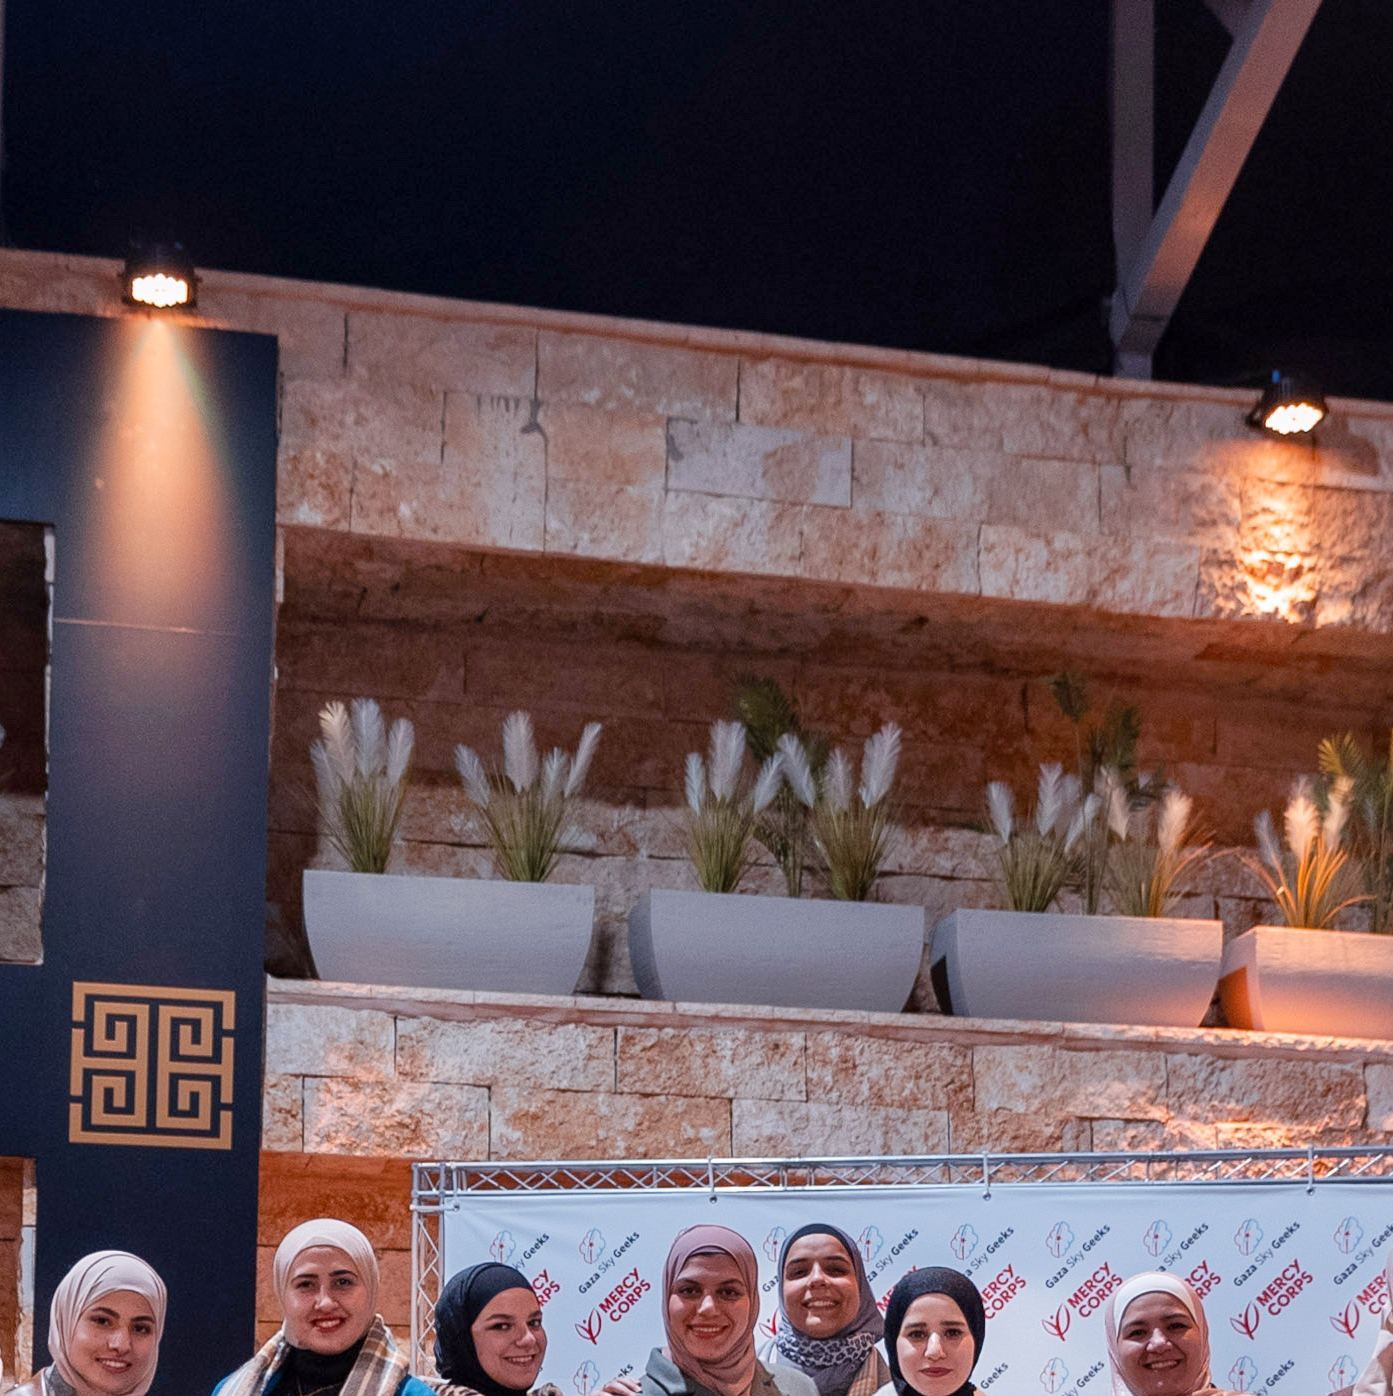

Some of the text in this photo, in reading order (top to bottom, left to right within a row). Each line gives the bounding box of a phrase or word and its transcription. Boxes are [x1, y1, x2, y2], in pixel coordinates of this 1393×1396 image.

[512, 1258, 526, 1271] ky
[523, 1233, 550, 1260] Geeks
[578, 1231, 640, 1294] Gaza Sky Geeks
[866, 1270, 878, 1283] za
[875, 1254, 894, 1272] Sky
[891, 1228, 919, 1256] Geeks
[969, 1226, 1015, 1271] Sky Geeks
[1045, 1224, 1111, 1289] Gaza Sky Geeks
[1163, 1222, 1209, 1266] Sky Geeks
[1233, 1221, 1301, 1287] Gaza Sky Geeks
[1333, 1263, 1358, 1285] Gaza
[1354, 1247, 1375, 1265] Sky
[537, 1280, 561, 1307] RPS
[598, 1267, 641, 1314] MERCY
[609, 1279, 651, 1322] CORPS
[762, 1275, 779, 1293] Gaz
[981, 1263, 1016, 1304] ERCY
[984, 1275, 1027, 1320] CORPS
[1067, 1261, 1112, 1309] MERCY
[1078, 1273, 1123, 1318] CORPS
[1196, 1271, 1222, 1299] RPS
[1256, 1258, 1301, 1307] MERCY
[1267, 1270, 1314, 1316] CORPS
[980, 1361, 1009, 1390] Geeks
[1076, 1360, 1105, 1388] Geeks
[1254, 1358, 1295, 1396] ky Geeks
